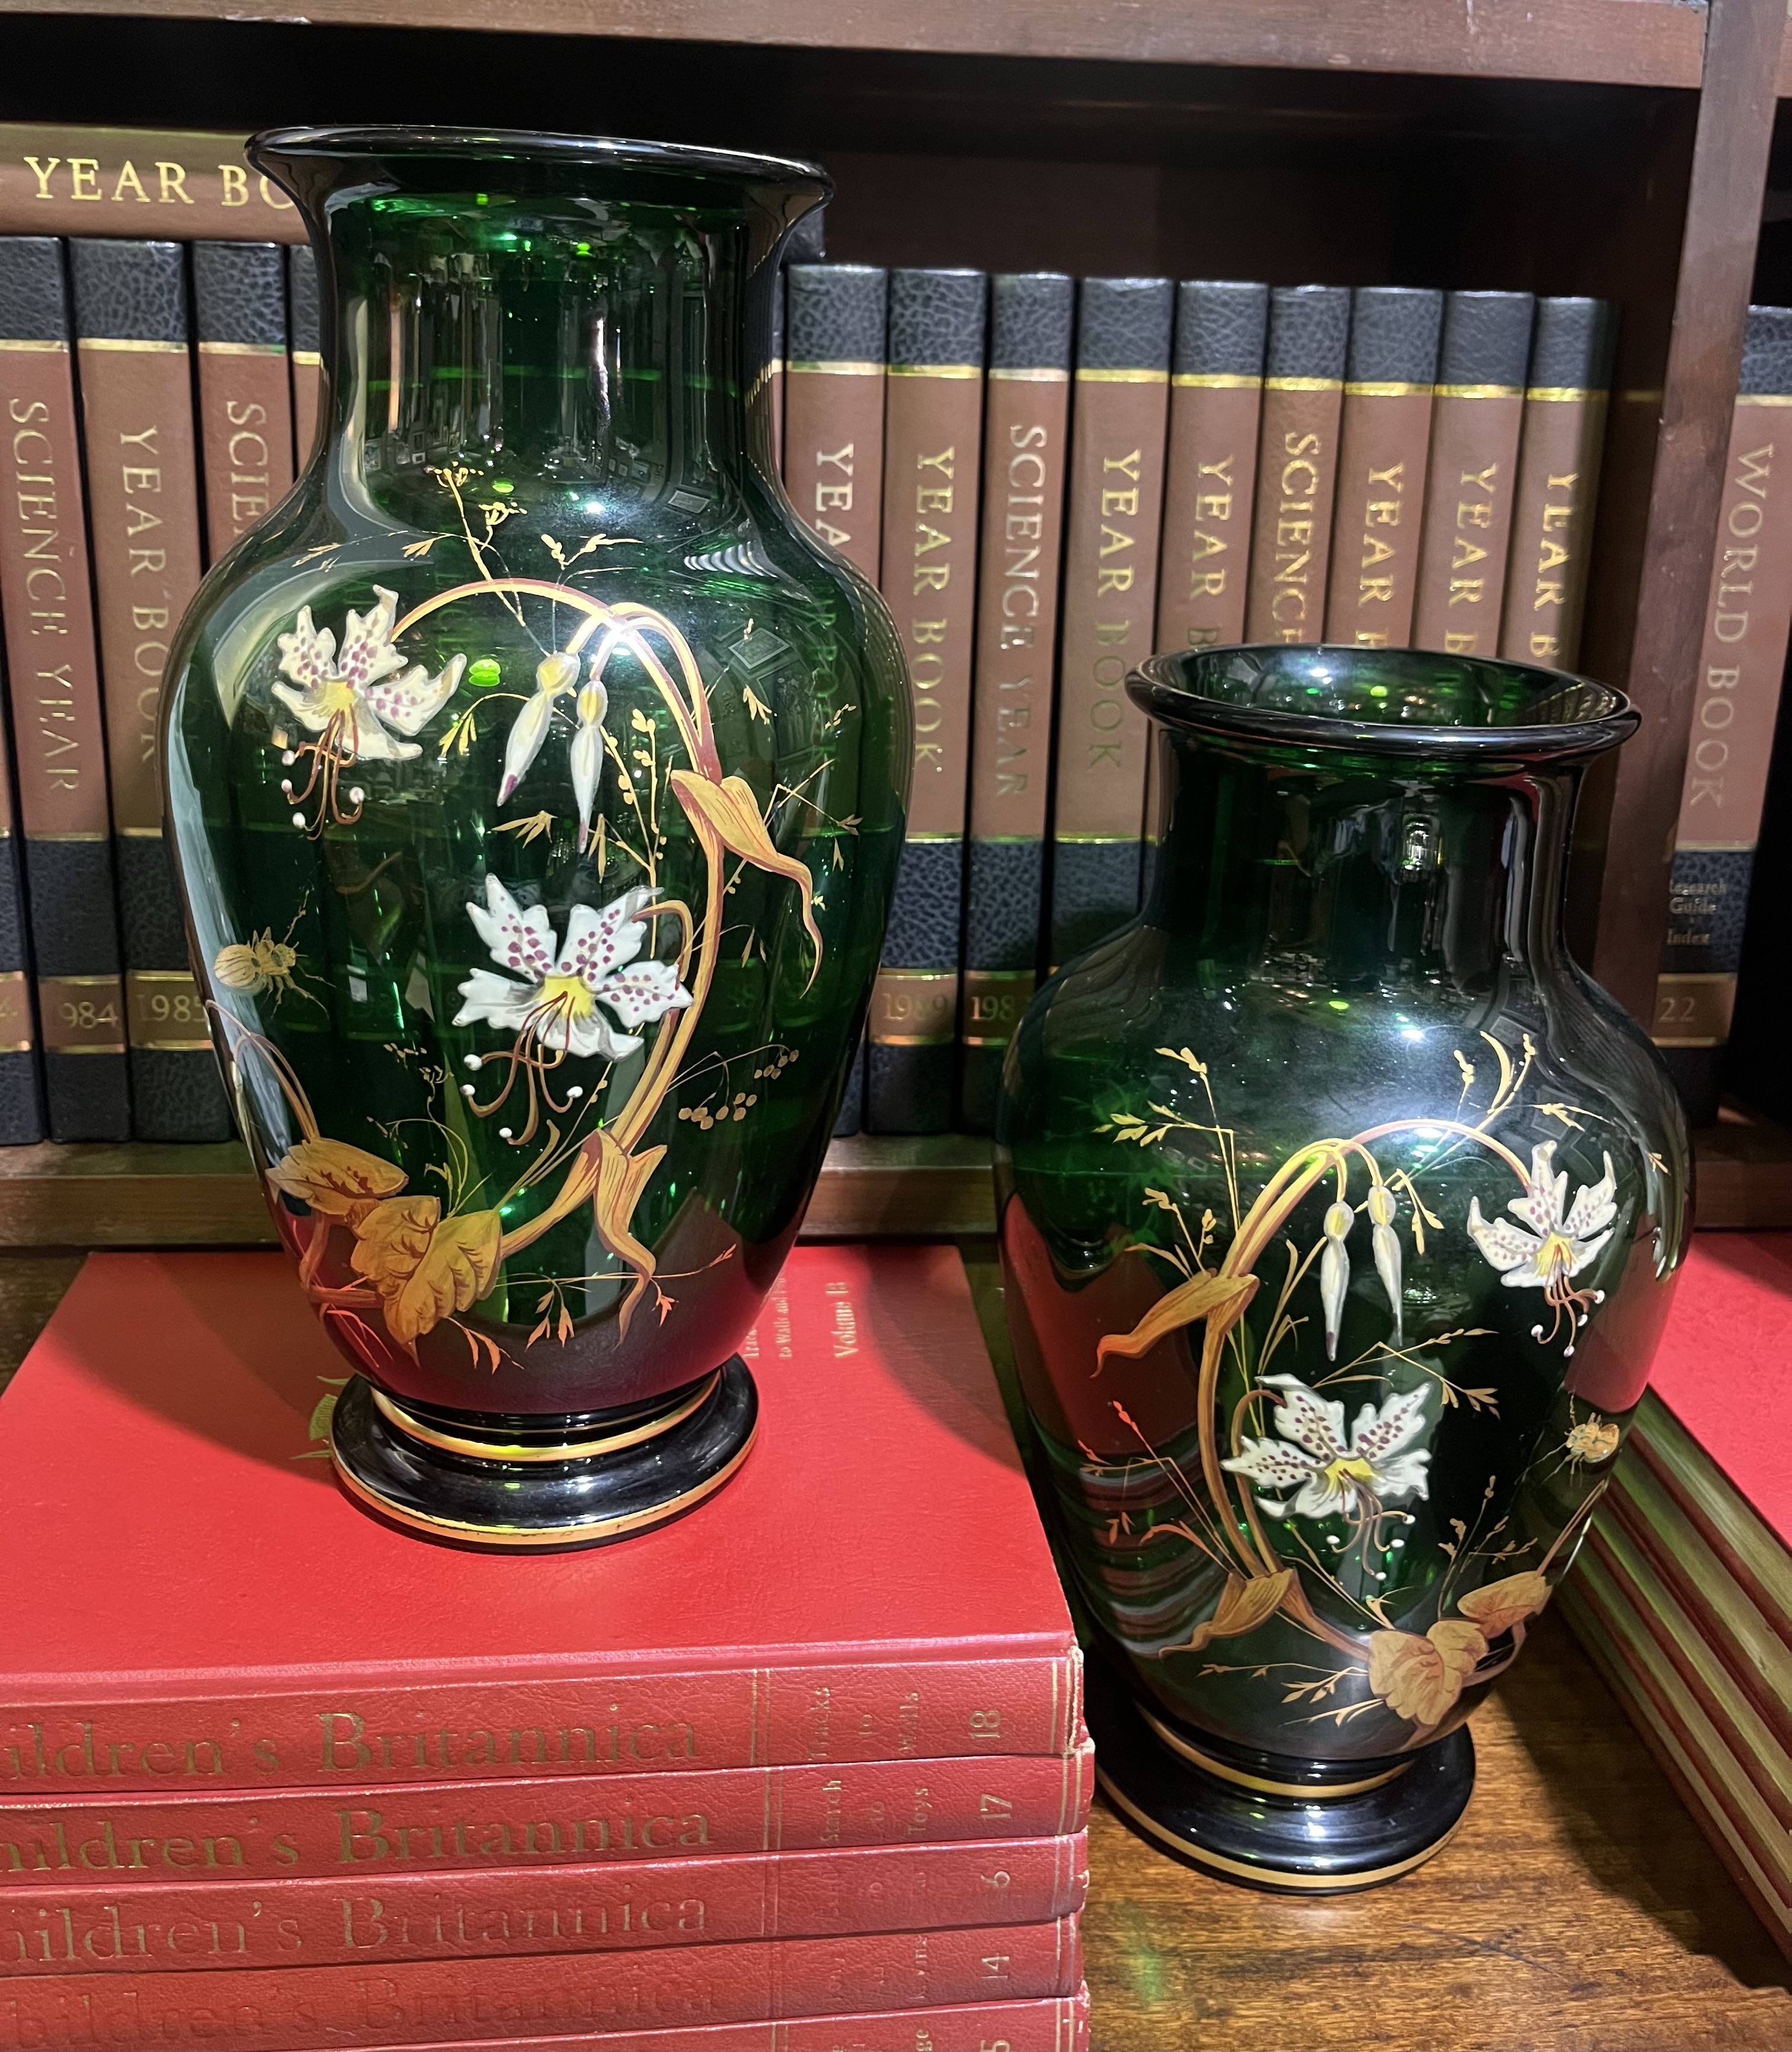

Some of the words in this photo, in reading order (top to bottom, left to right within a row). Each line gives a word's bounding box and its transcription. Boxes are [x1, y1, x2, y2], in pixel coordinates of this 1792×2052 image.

[24, 156, 194, 204] YEAR
[9, 398, 69, 635] SCIENCE
[120, 425, 167, 578] YEAR
[226, 401, 271, 536] SCIE
[913, 446, 955, 596] YEAR
[1097, 448, 1141, 597] YEAR
[1189, 453, 1234, 599] YEAR
[1001, 425, 1048, 649] SCIENCE
[1358, 462, 1404, 607] YEAR
[1448, 463, 1499, 607] YEAR
[1534, 472, 1579, 611] YEAR
[1714, 443, 1774, 643] WORLD
[37, 664, 80, 790] YEAR
[911, 618, 948, 772] BOOK
[996, 674, 1032, 796] YEAR
[1088, 620, 1131, 771] BOOK
[1689, 665, 1740, 808] BOOK
[1659, 997, 1695, 1023] 22
[831, 1301, 859, 1358] Volume
[318, 1701, 702, 1772] Britannica
[808, 1686, 830, 1760] Trucks
[858, 1714, 872, 1736] to
[898, 1692, 920, 1753] Walls
[969, 1709, 1001, 1740] 18
[335, 1795, 714, 1865] Britannica
[869, 1801, 885, 1823] to
[907, 1787, 933, 1835] Toys
[981, 1793, 1012, 1822] 17
[337, 1883, 706, 1949] Britannica
[980, 1870, 1011, 1890] 6
[982, 1953, 1010, 1980] 14
